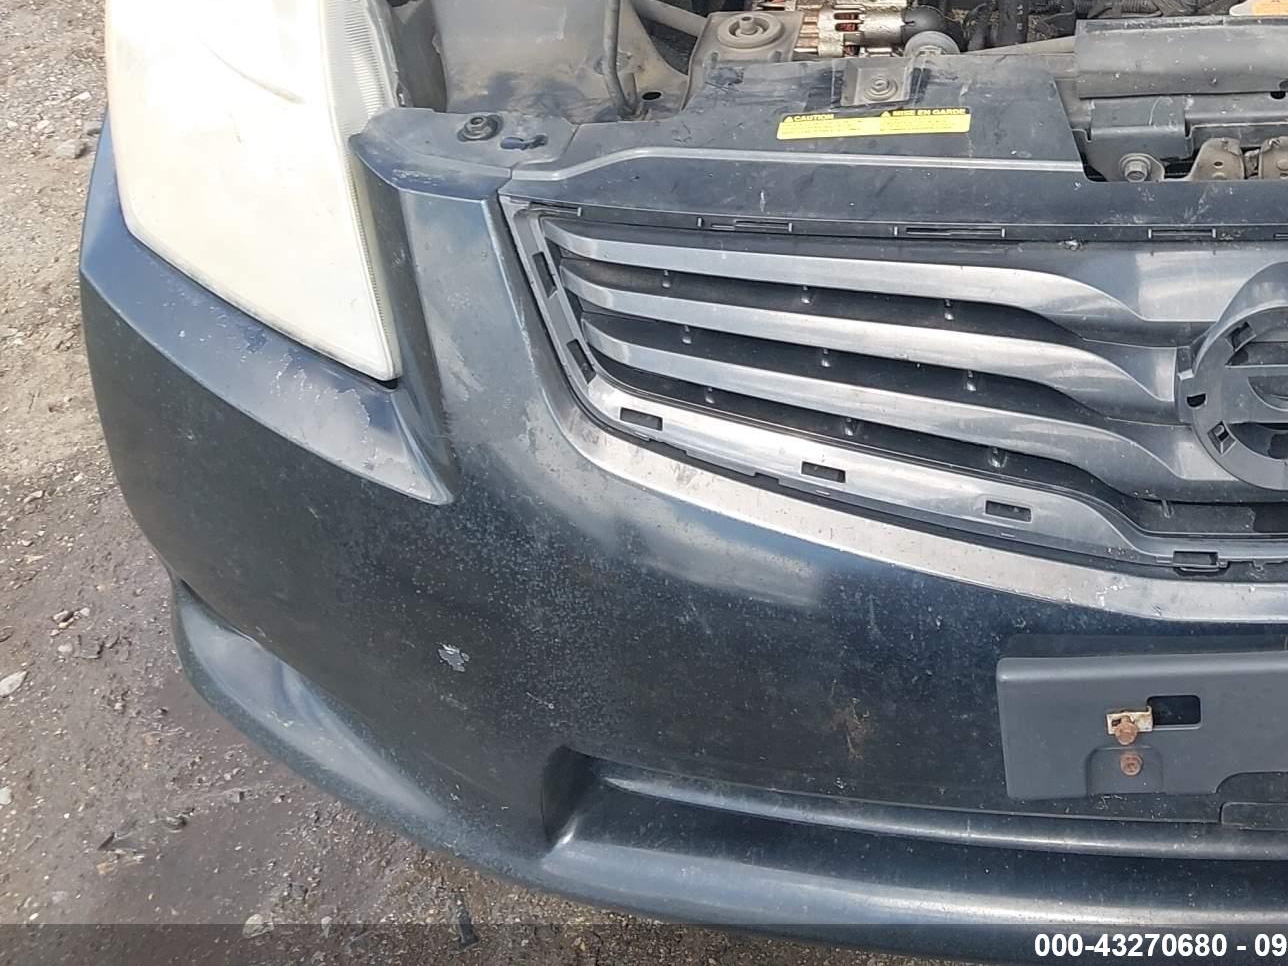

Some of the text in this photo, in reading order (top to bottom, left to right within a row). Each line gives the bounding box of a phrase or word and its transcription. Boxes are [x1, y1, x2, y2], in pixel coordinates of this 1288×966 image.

[917, 108, 931, 116] EN
[932, 108, 966, 116] GARDE
[794, 113, 835, 123] CAUTION
